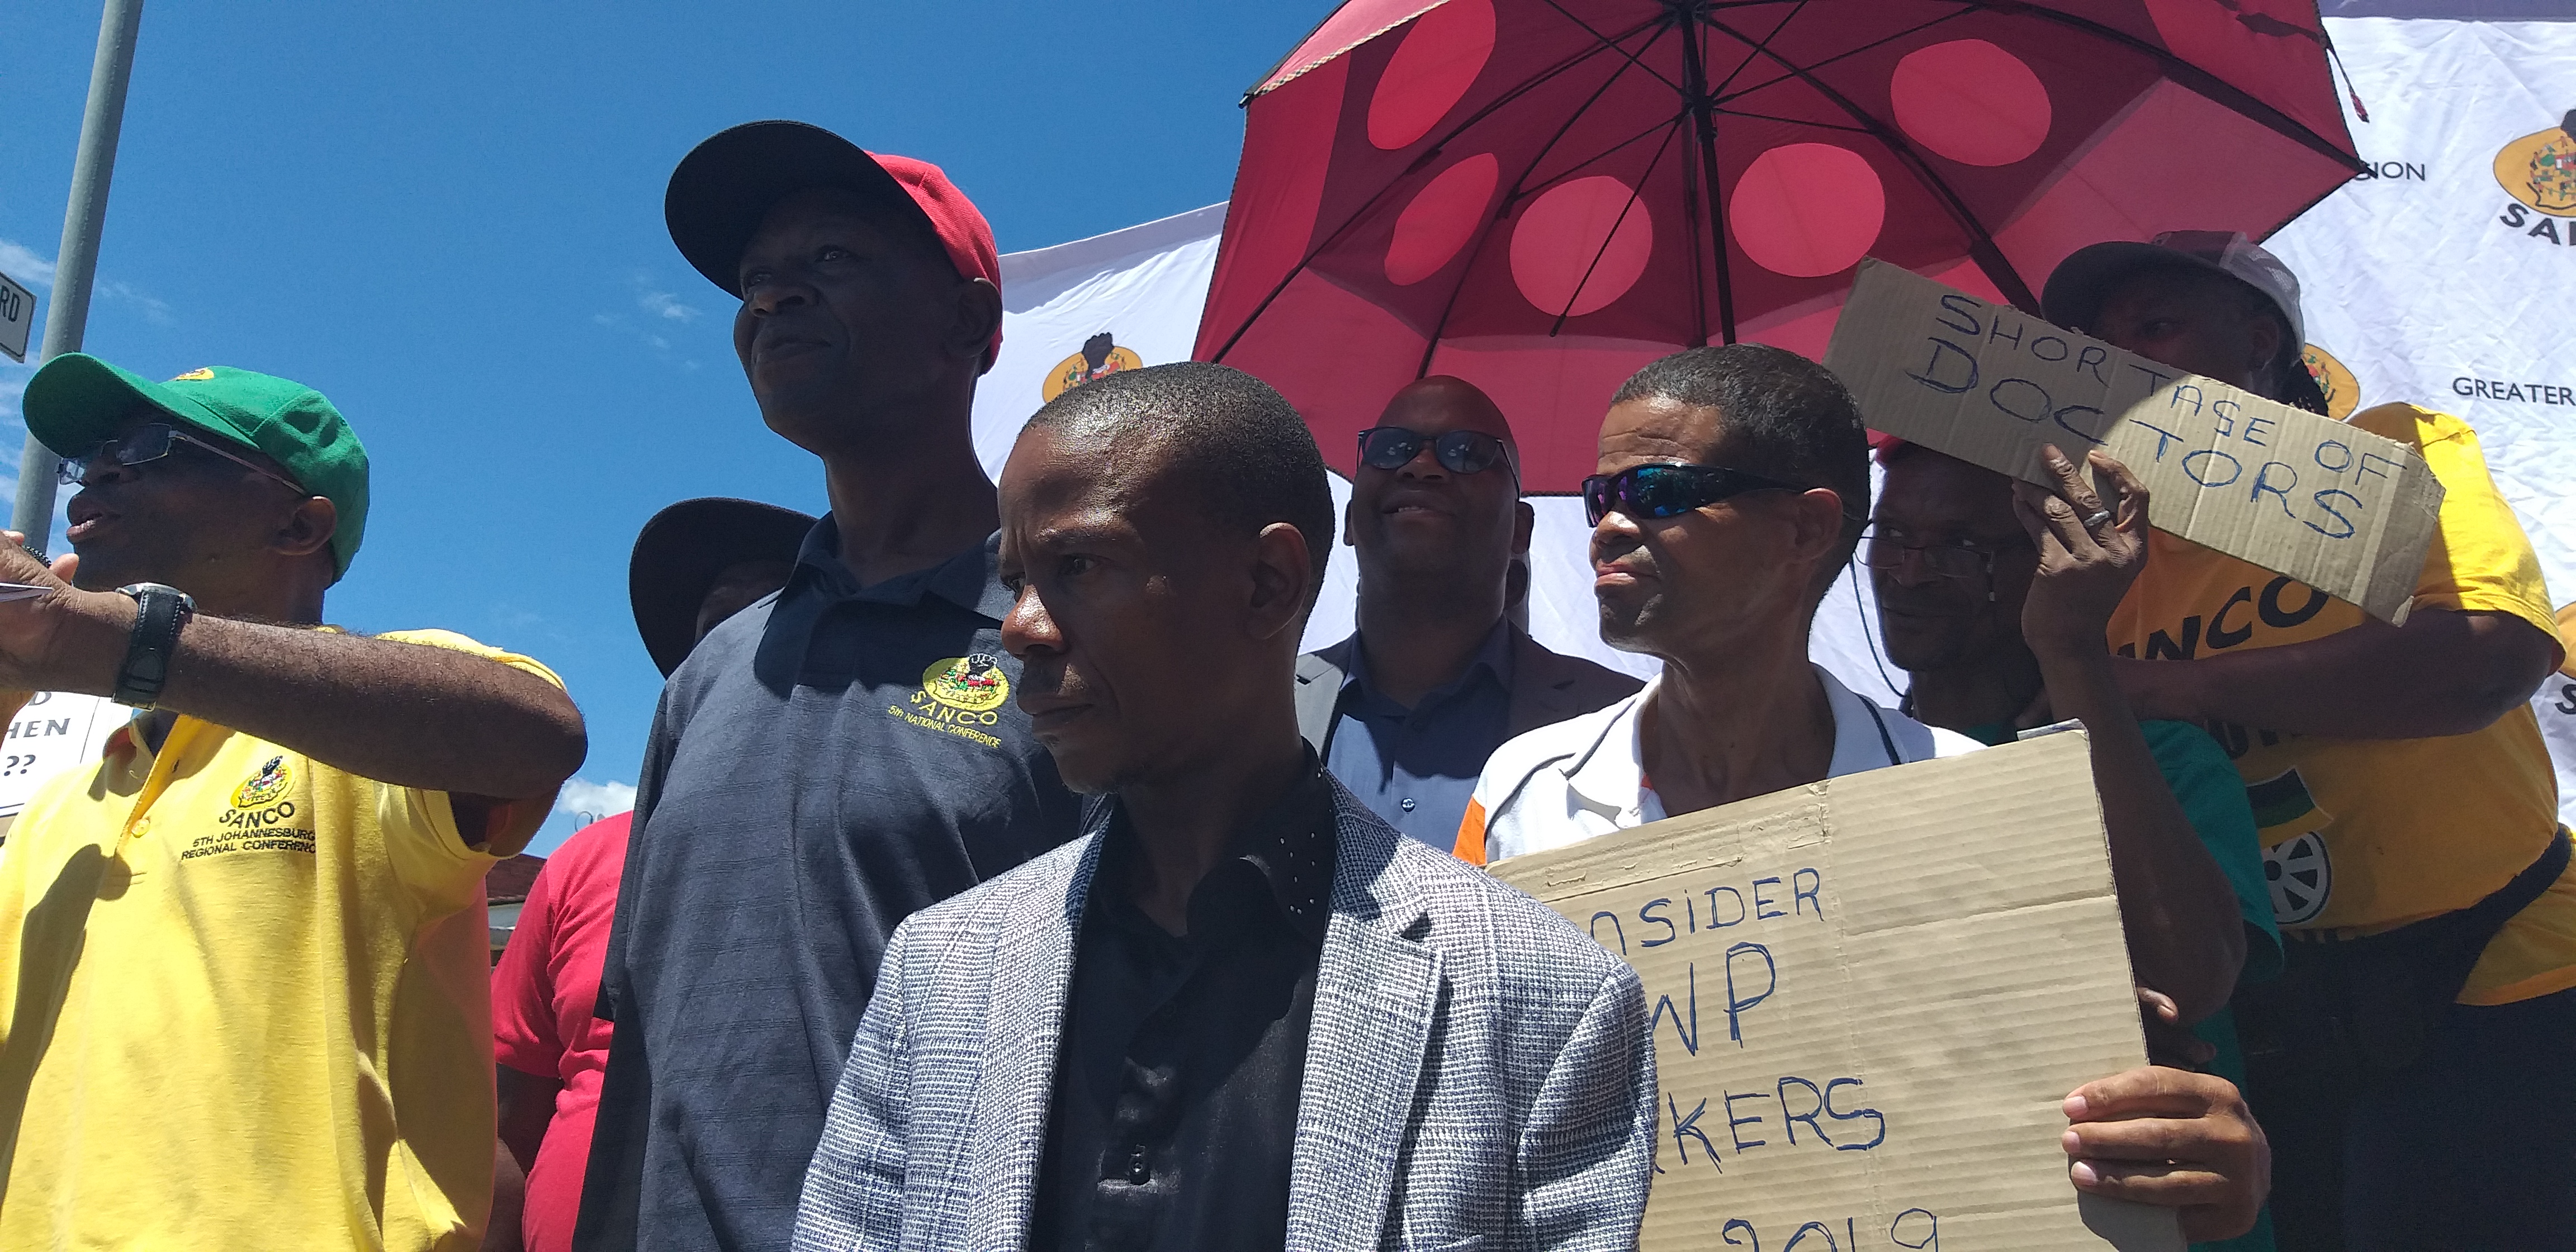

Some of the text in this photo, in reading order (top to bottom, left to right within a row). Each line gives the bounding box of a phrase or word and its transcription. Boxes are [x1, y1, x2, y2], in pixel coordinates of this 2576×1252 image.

[2452, 376, 2576, 406] GREATER
[2314, 439, 2408, 485] OF
[2117, 575, 2330, 661] NCO
[910, 690, 998, 726] SANCO
[904, 712, 946, 732] NATIONAL
[946, 724, 1002, 749] CONFERENCE
[219, 801, 296, 829] SANCO
[181, 842, 237, 861] REGIONAL
[1654, 1076, 1886, 1175] KERS
